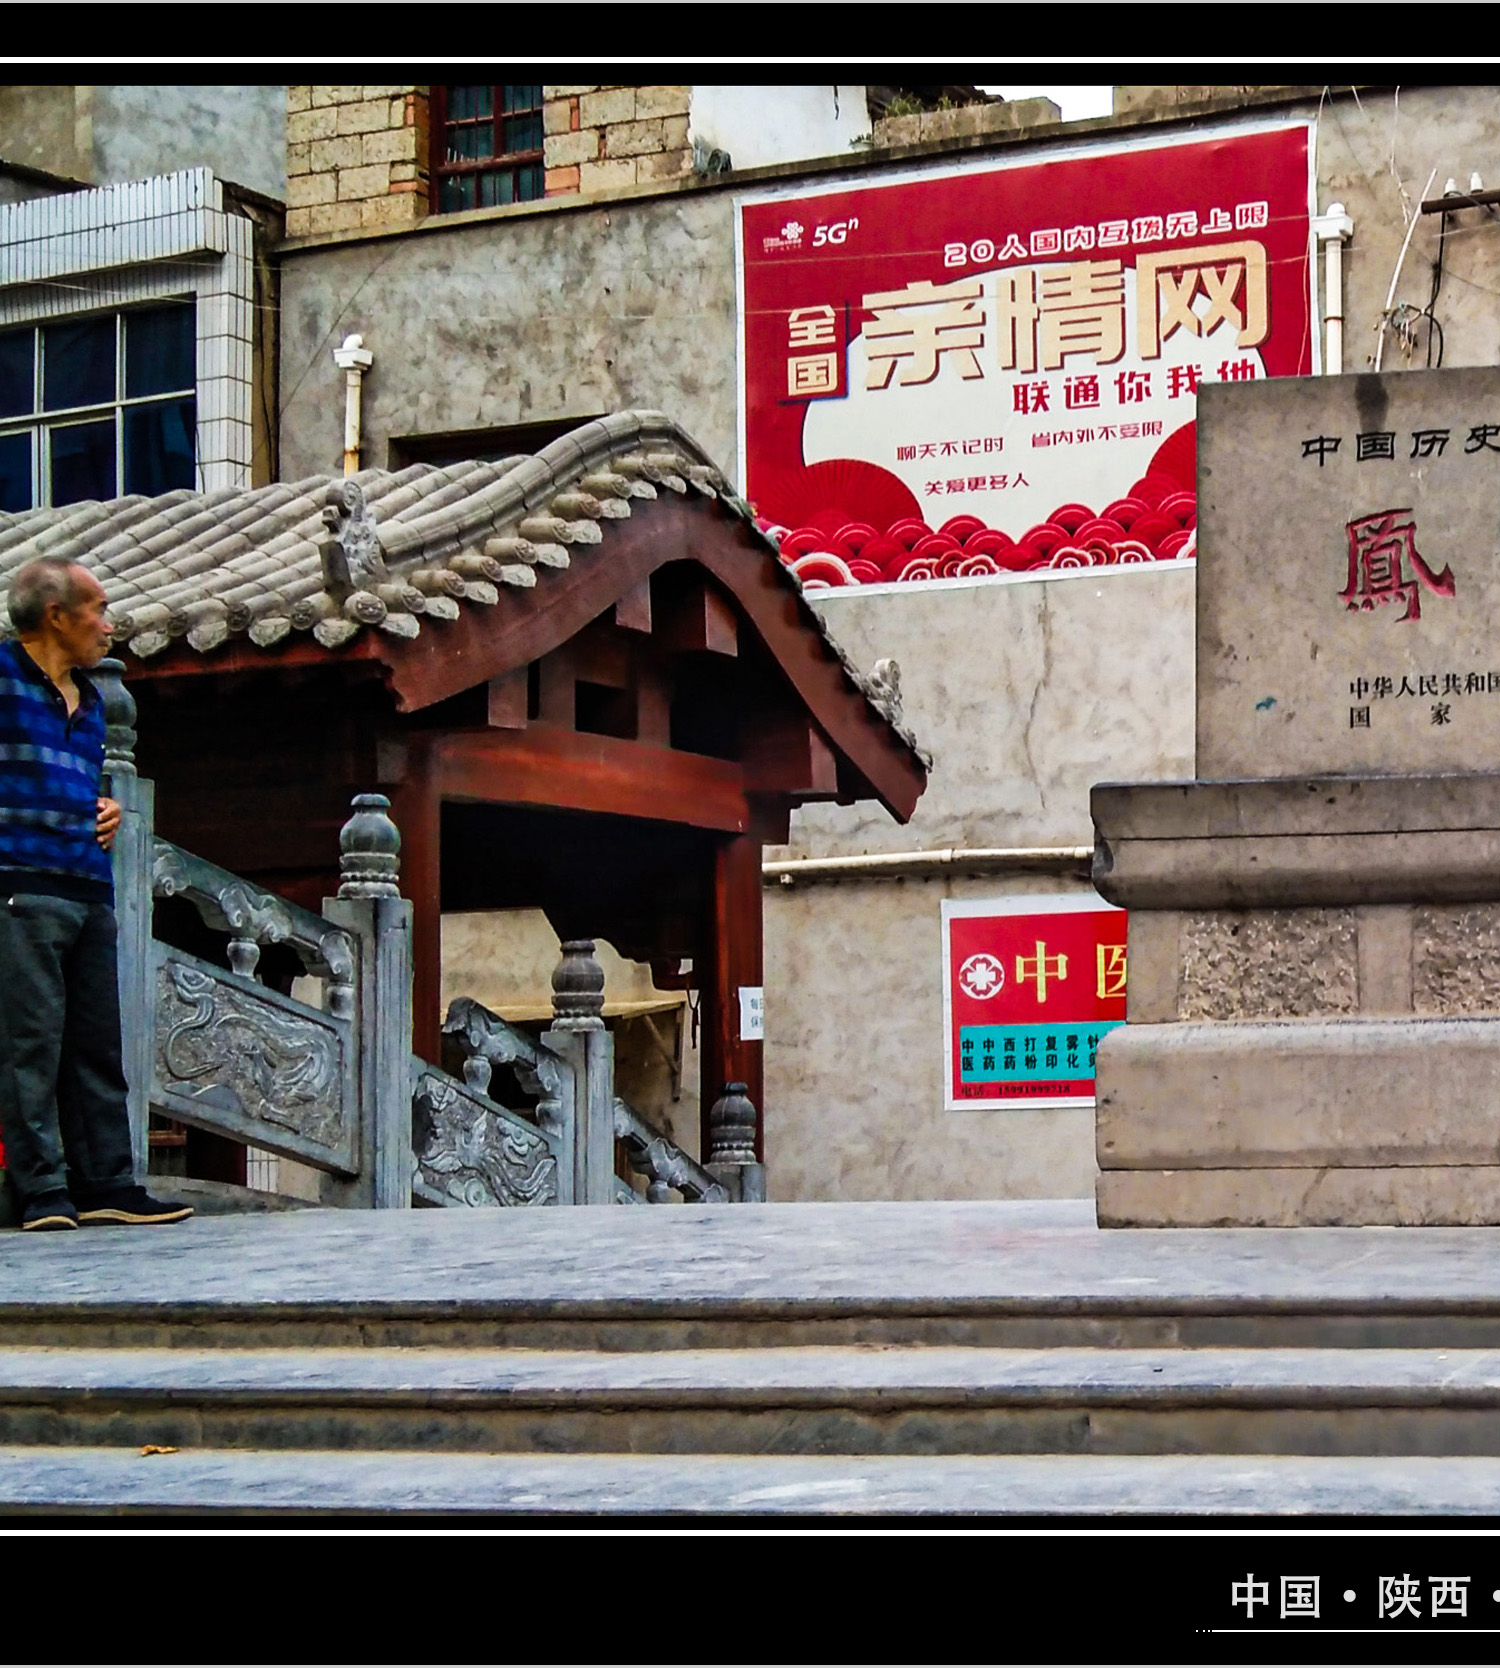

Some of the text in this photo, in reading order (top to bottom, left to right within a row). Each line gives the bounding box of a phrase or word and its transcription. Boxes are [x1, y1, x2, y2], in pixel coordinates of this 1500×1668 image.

[943, 201, 1269, 267] 20人国内互拨无上限
[861, 239, 1270, 390] 亲情网
[787, 304, 838, 397] 全国
[897, 420, 1163, 461] 聊天不记时 省内外不受限
[924, 473, 1030, 496] 关爱更多人
